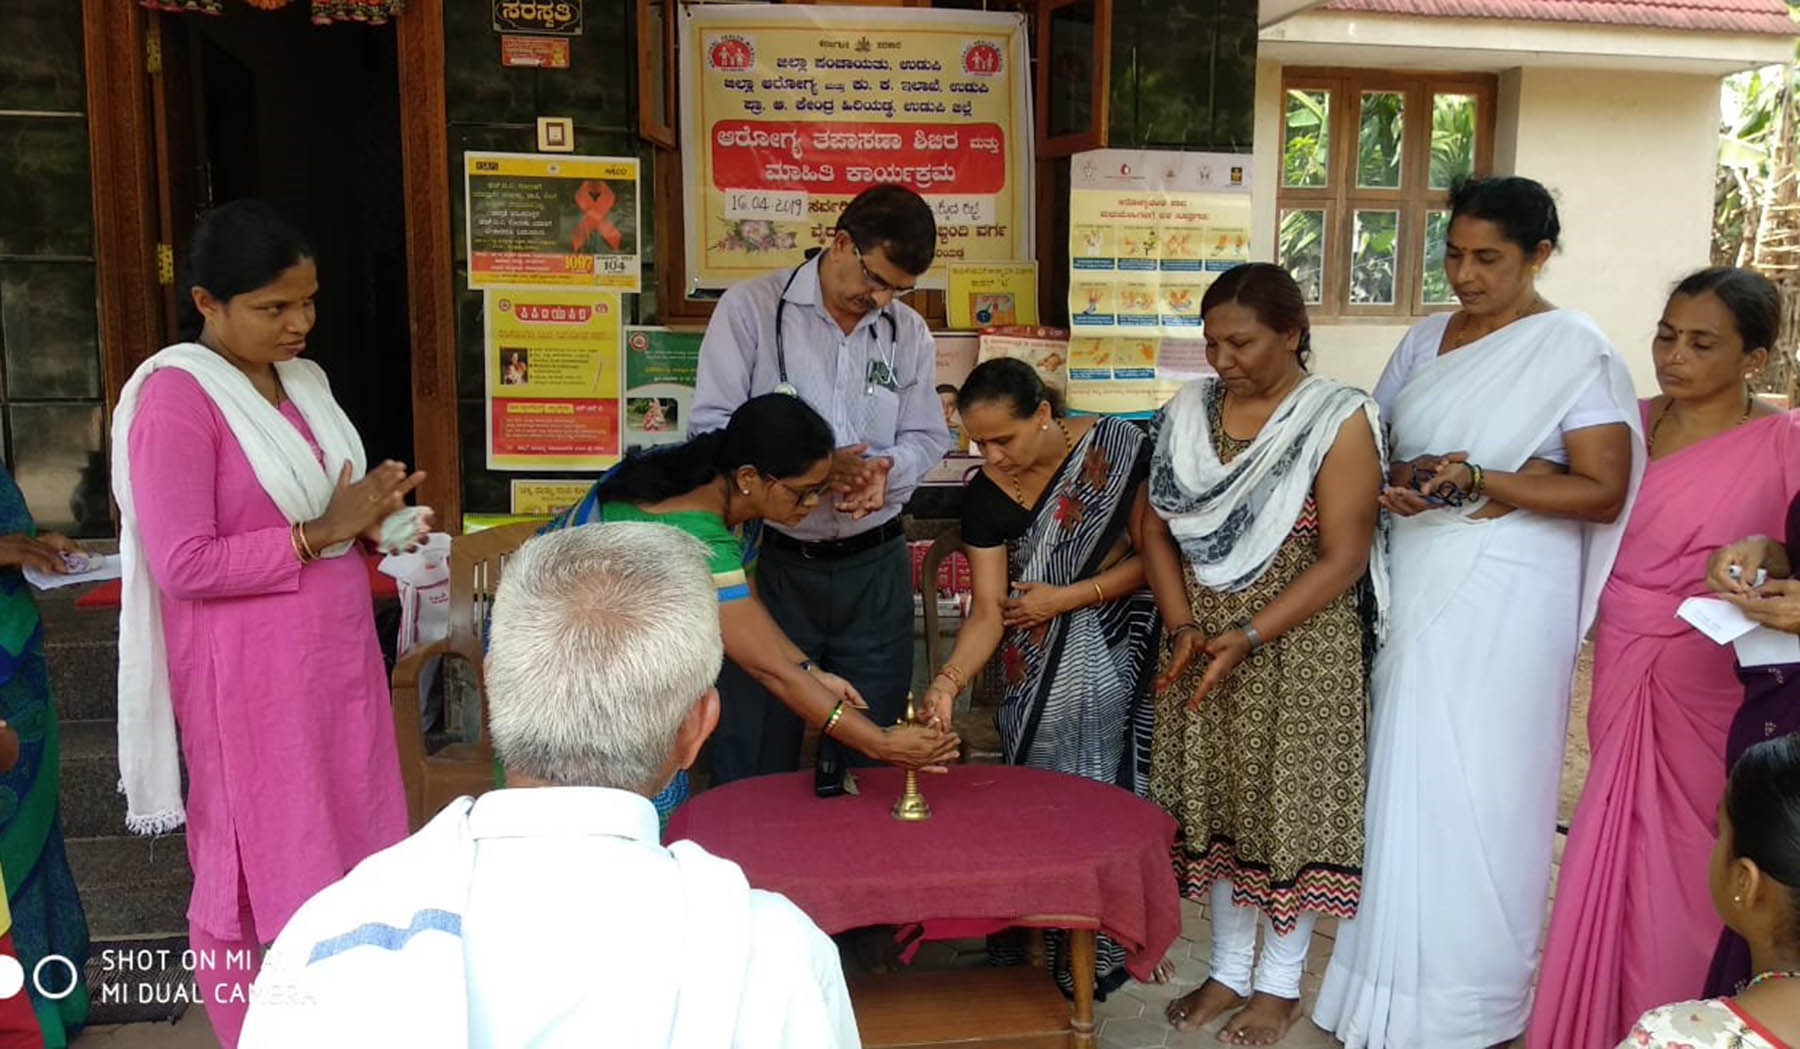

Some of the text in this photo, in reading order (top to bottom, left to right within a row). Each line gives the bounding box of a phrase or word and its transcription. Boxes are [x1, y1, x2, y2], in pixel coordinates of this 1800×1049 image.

[503, 2, 572, 27] ಸರಸ್ವತಿ
[776, 57, 808, 72] ಜಿಲ್ಲಾ
[899, 58, 942, 71] ಉಡುಪಿ
[724, 78, 754, 93] ಜಿಲ್ಲಾ
[761, 76, 818, 95] ಆರೋಗ್ಯ
[949, 81, 989, 93] ಉಡುಪಿ
[796, 97, 834, 115] ಕೇಂದ್ರ
[904, 101, 945, 112] ಉಡುಪಿ
[952, 100, 973, 116] ಜಿಲ್ಲೆ
[717, 126, 1000, 158] ಆರೋಗ್ಯ ತಪಾಸಣಾ ಶಿಬಿರ ಮತ್ತು
[764, 162, 956, 188] ಮಾಹಿತಿ ಕಾರ್ಯಕ್ರಮ
[976, 224, 1009, 237] ವರ್ಗ
[604, 261, 626, 271] 104
